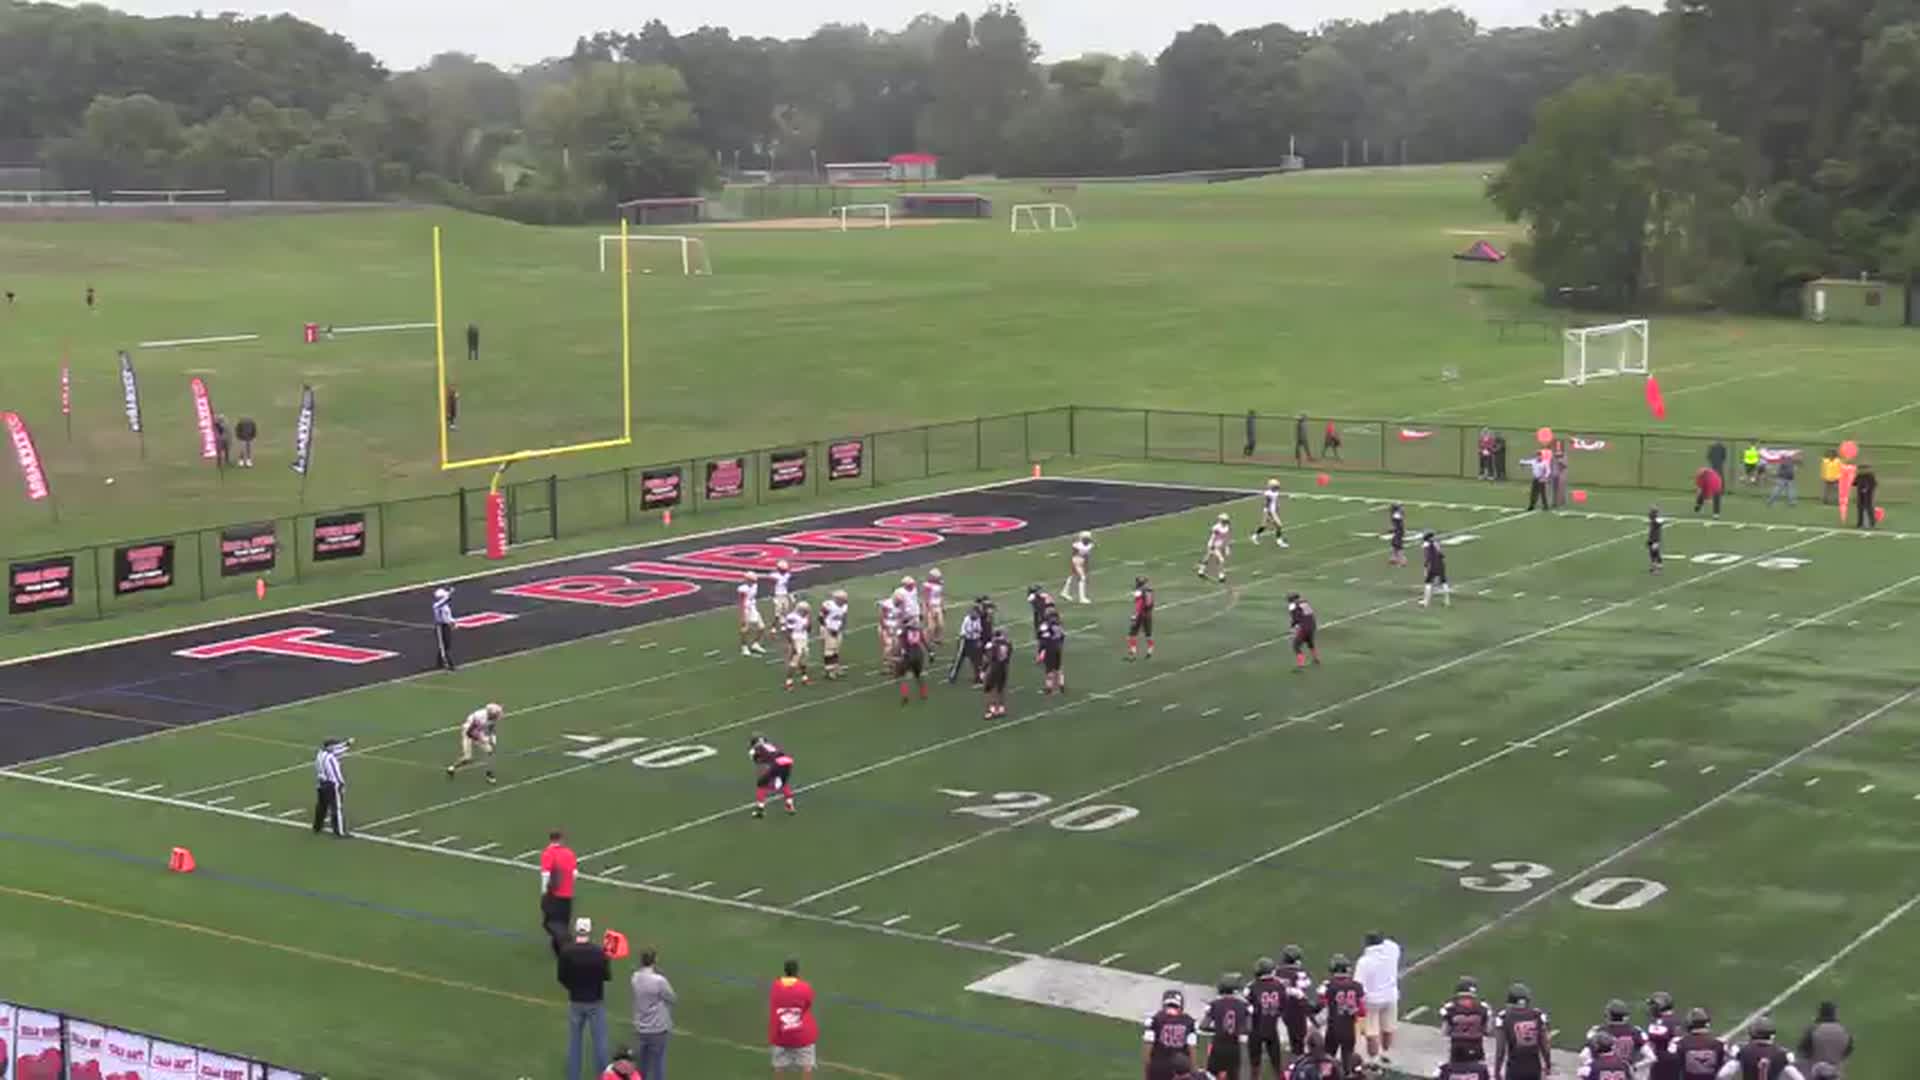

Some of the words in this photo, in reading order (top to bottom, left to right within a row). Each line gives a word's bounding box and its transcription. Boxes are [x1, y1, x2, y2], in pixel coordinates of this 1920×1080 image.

[562, 737, 718, 768] 10
[948, 791, 1140, 831] 20
[1459, 861, 1668, 910] 30
